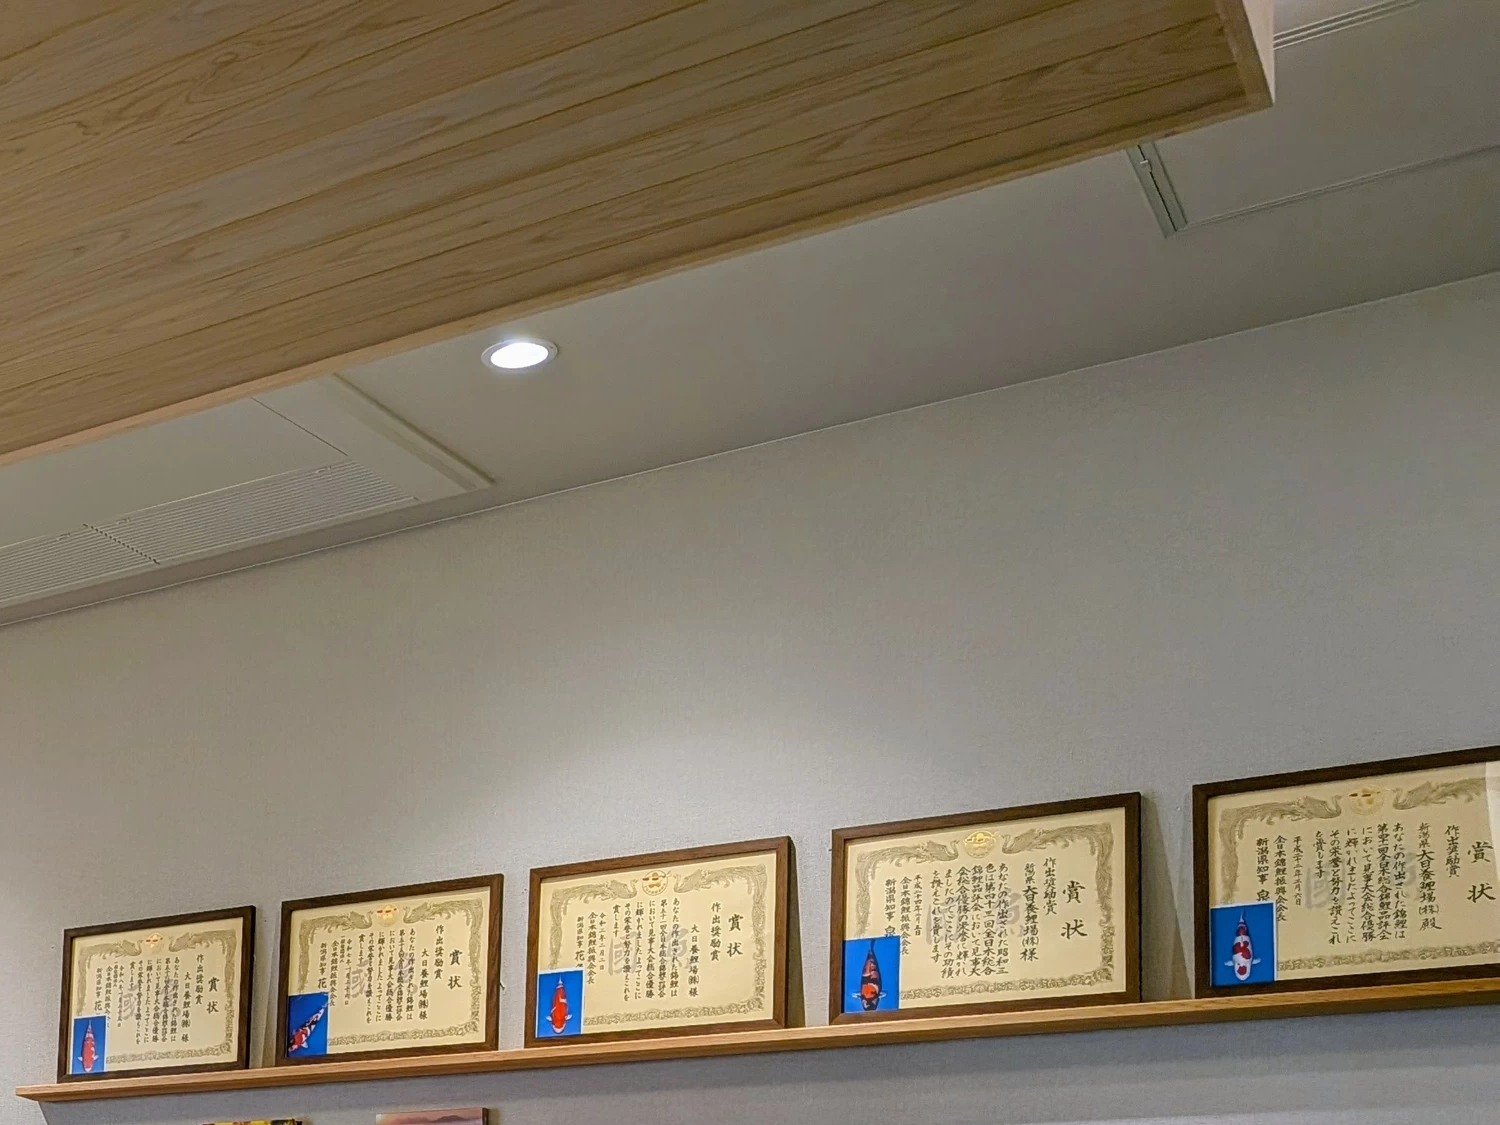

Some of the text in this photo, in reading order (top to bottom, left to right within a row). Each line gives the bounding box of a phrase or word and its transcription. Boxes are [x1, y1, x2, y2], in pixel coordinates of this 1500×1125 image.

[1256, 837, 1270, 884] 新潟県知事
[1392, 823, 1408, 939] あなたの作出された錦鯉は
[1468, 841, 1496, 903] 賞状
[612, 904, 621, 937] 賞します
[885, 879, 897, 922] 新潟県知事
[1060, 880, 1088, 939] 賞状
[434, 925, 444, 979] 作出奨励賞
[670, 898, 680, 997] あなたの作出された錦鯉は
[710, 902, 721, 961] 作出奨励賞
[726, 914, 744, 957] 賞状
[448, 949, 463, 989] 賞状
[207, 977, 220, 1014] 賞状
